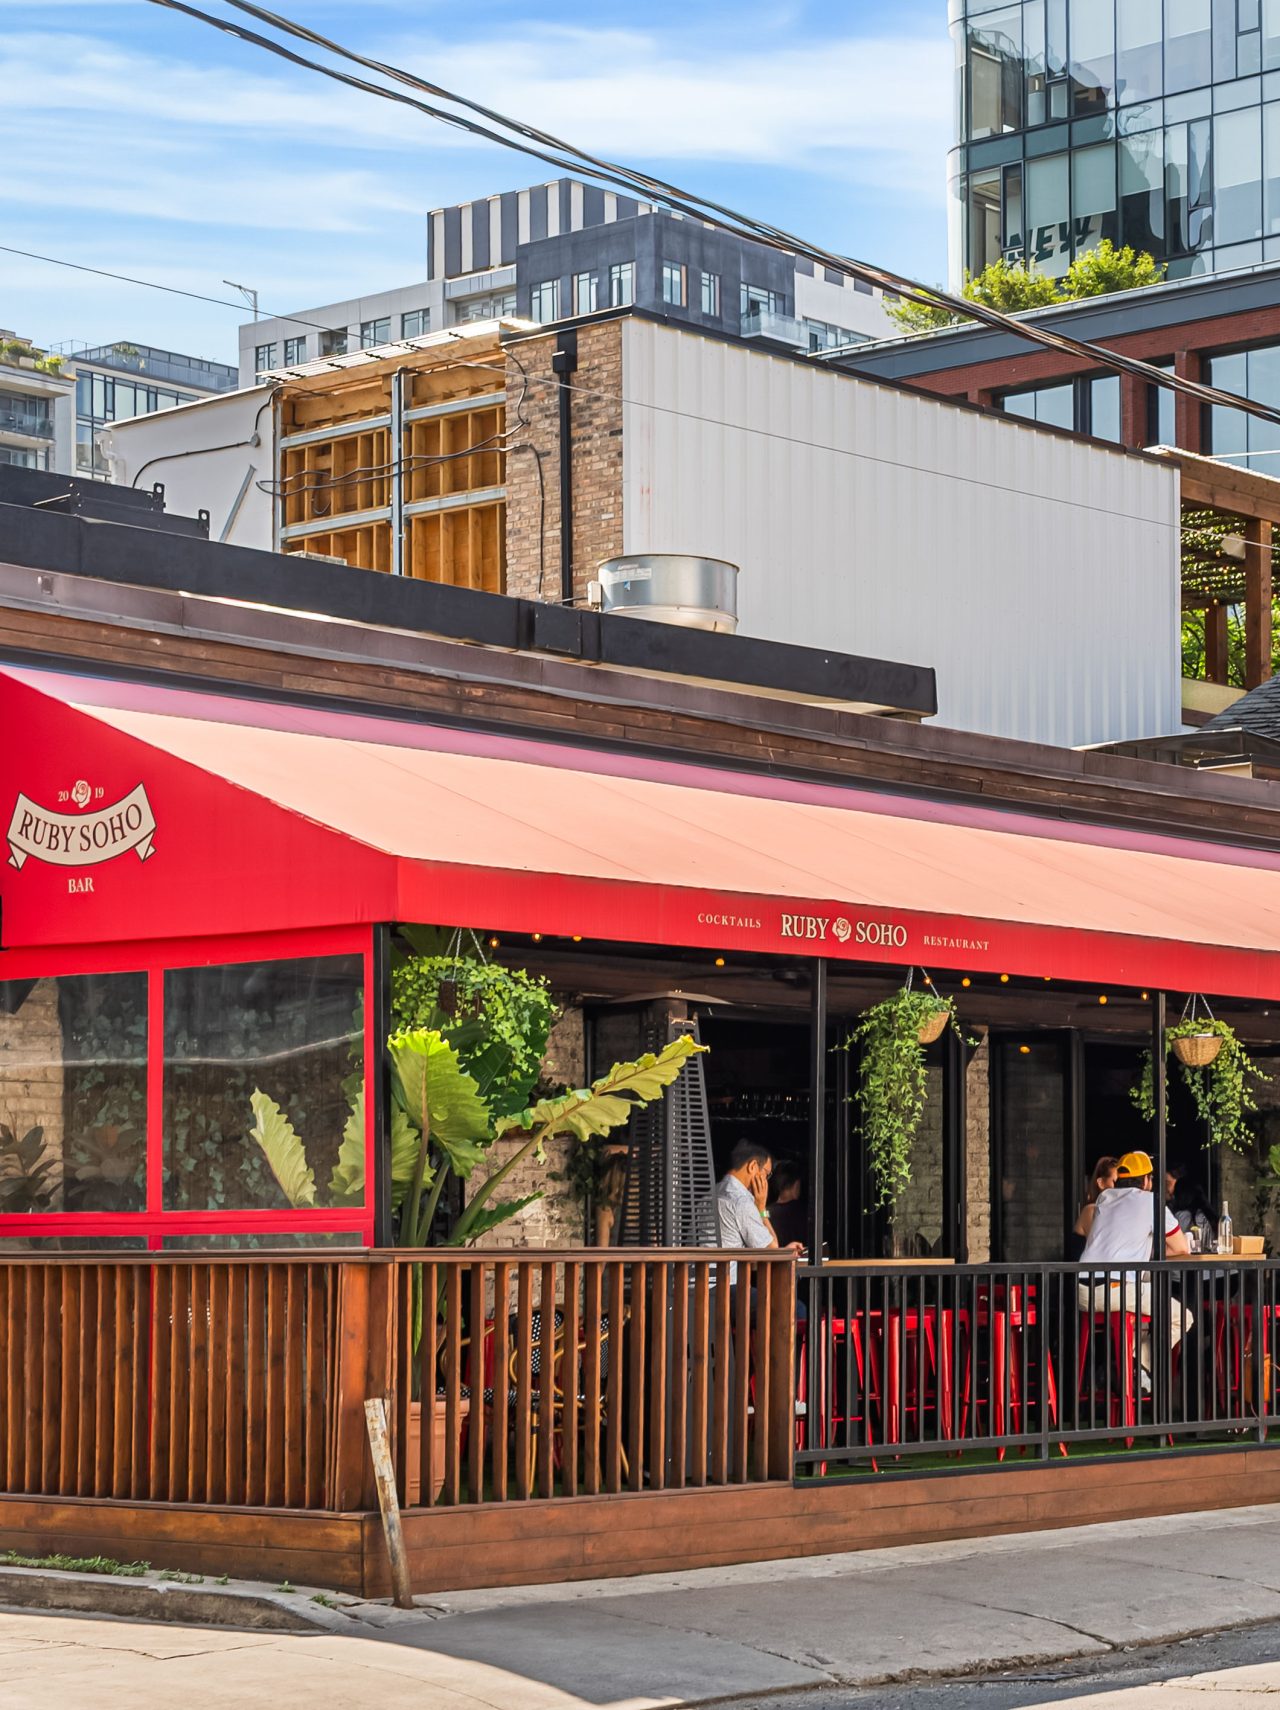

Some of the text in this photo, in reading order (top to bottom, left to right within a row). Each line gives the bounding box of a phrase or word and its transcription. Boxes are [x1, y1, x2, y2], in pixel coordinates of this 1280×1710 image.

[1006, 215, 1094, 268] NEW
[58, 787, 104, 802] 20 19
[18, 804, 142, 853] RUBY SOHO
[68, 877, 94, 893] BAR
[697, 912, 990, 951] COCKTAILS RUBY SOHO RESTAURANT
